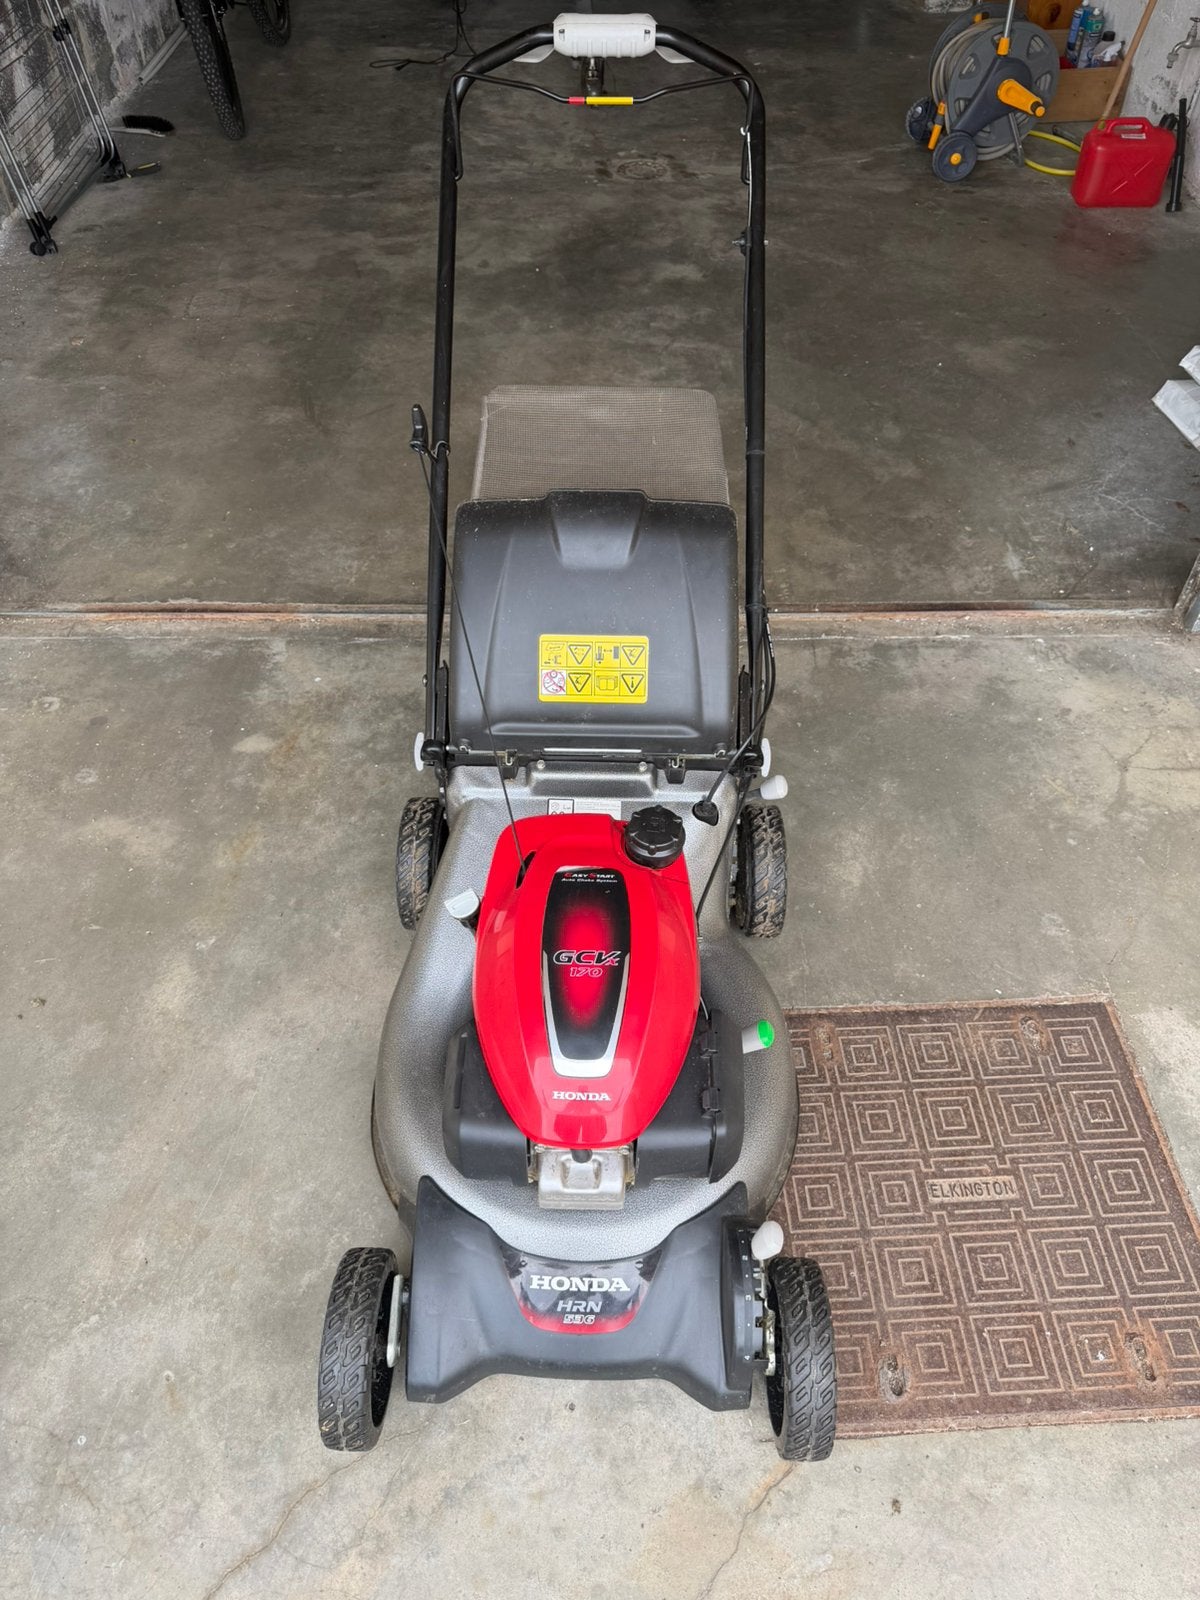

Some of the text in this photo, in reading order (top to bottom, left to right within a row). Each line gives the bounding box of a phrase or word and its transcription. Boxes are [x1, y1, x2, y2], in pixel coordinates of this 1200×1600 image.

[570, 966, 603, 978] 170
[552, 1091, 612, 1102] HONDA
[929, 1180, 1016, 1199] ELKINGTON
[529, 1274, 631, 1293] HONDA
[556, 1300, 603, 1313] HRN
[562, 1313, 596, 1326] 536
